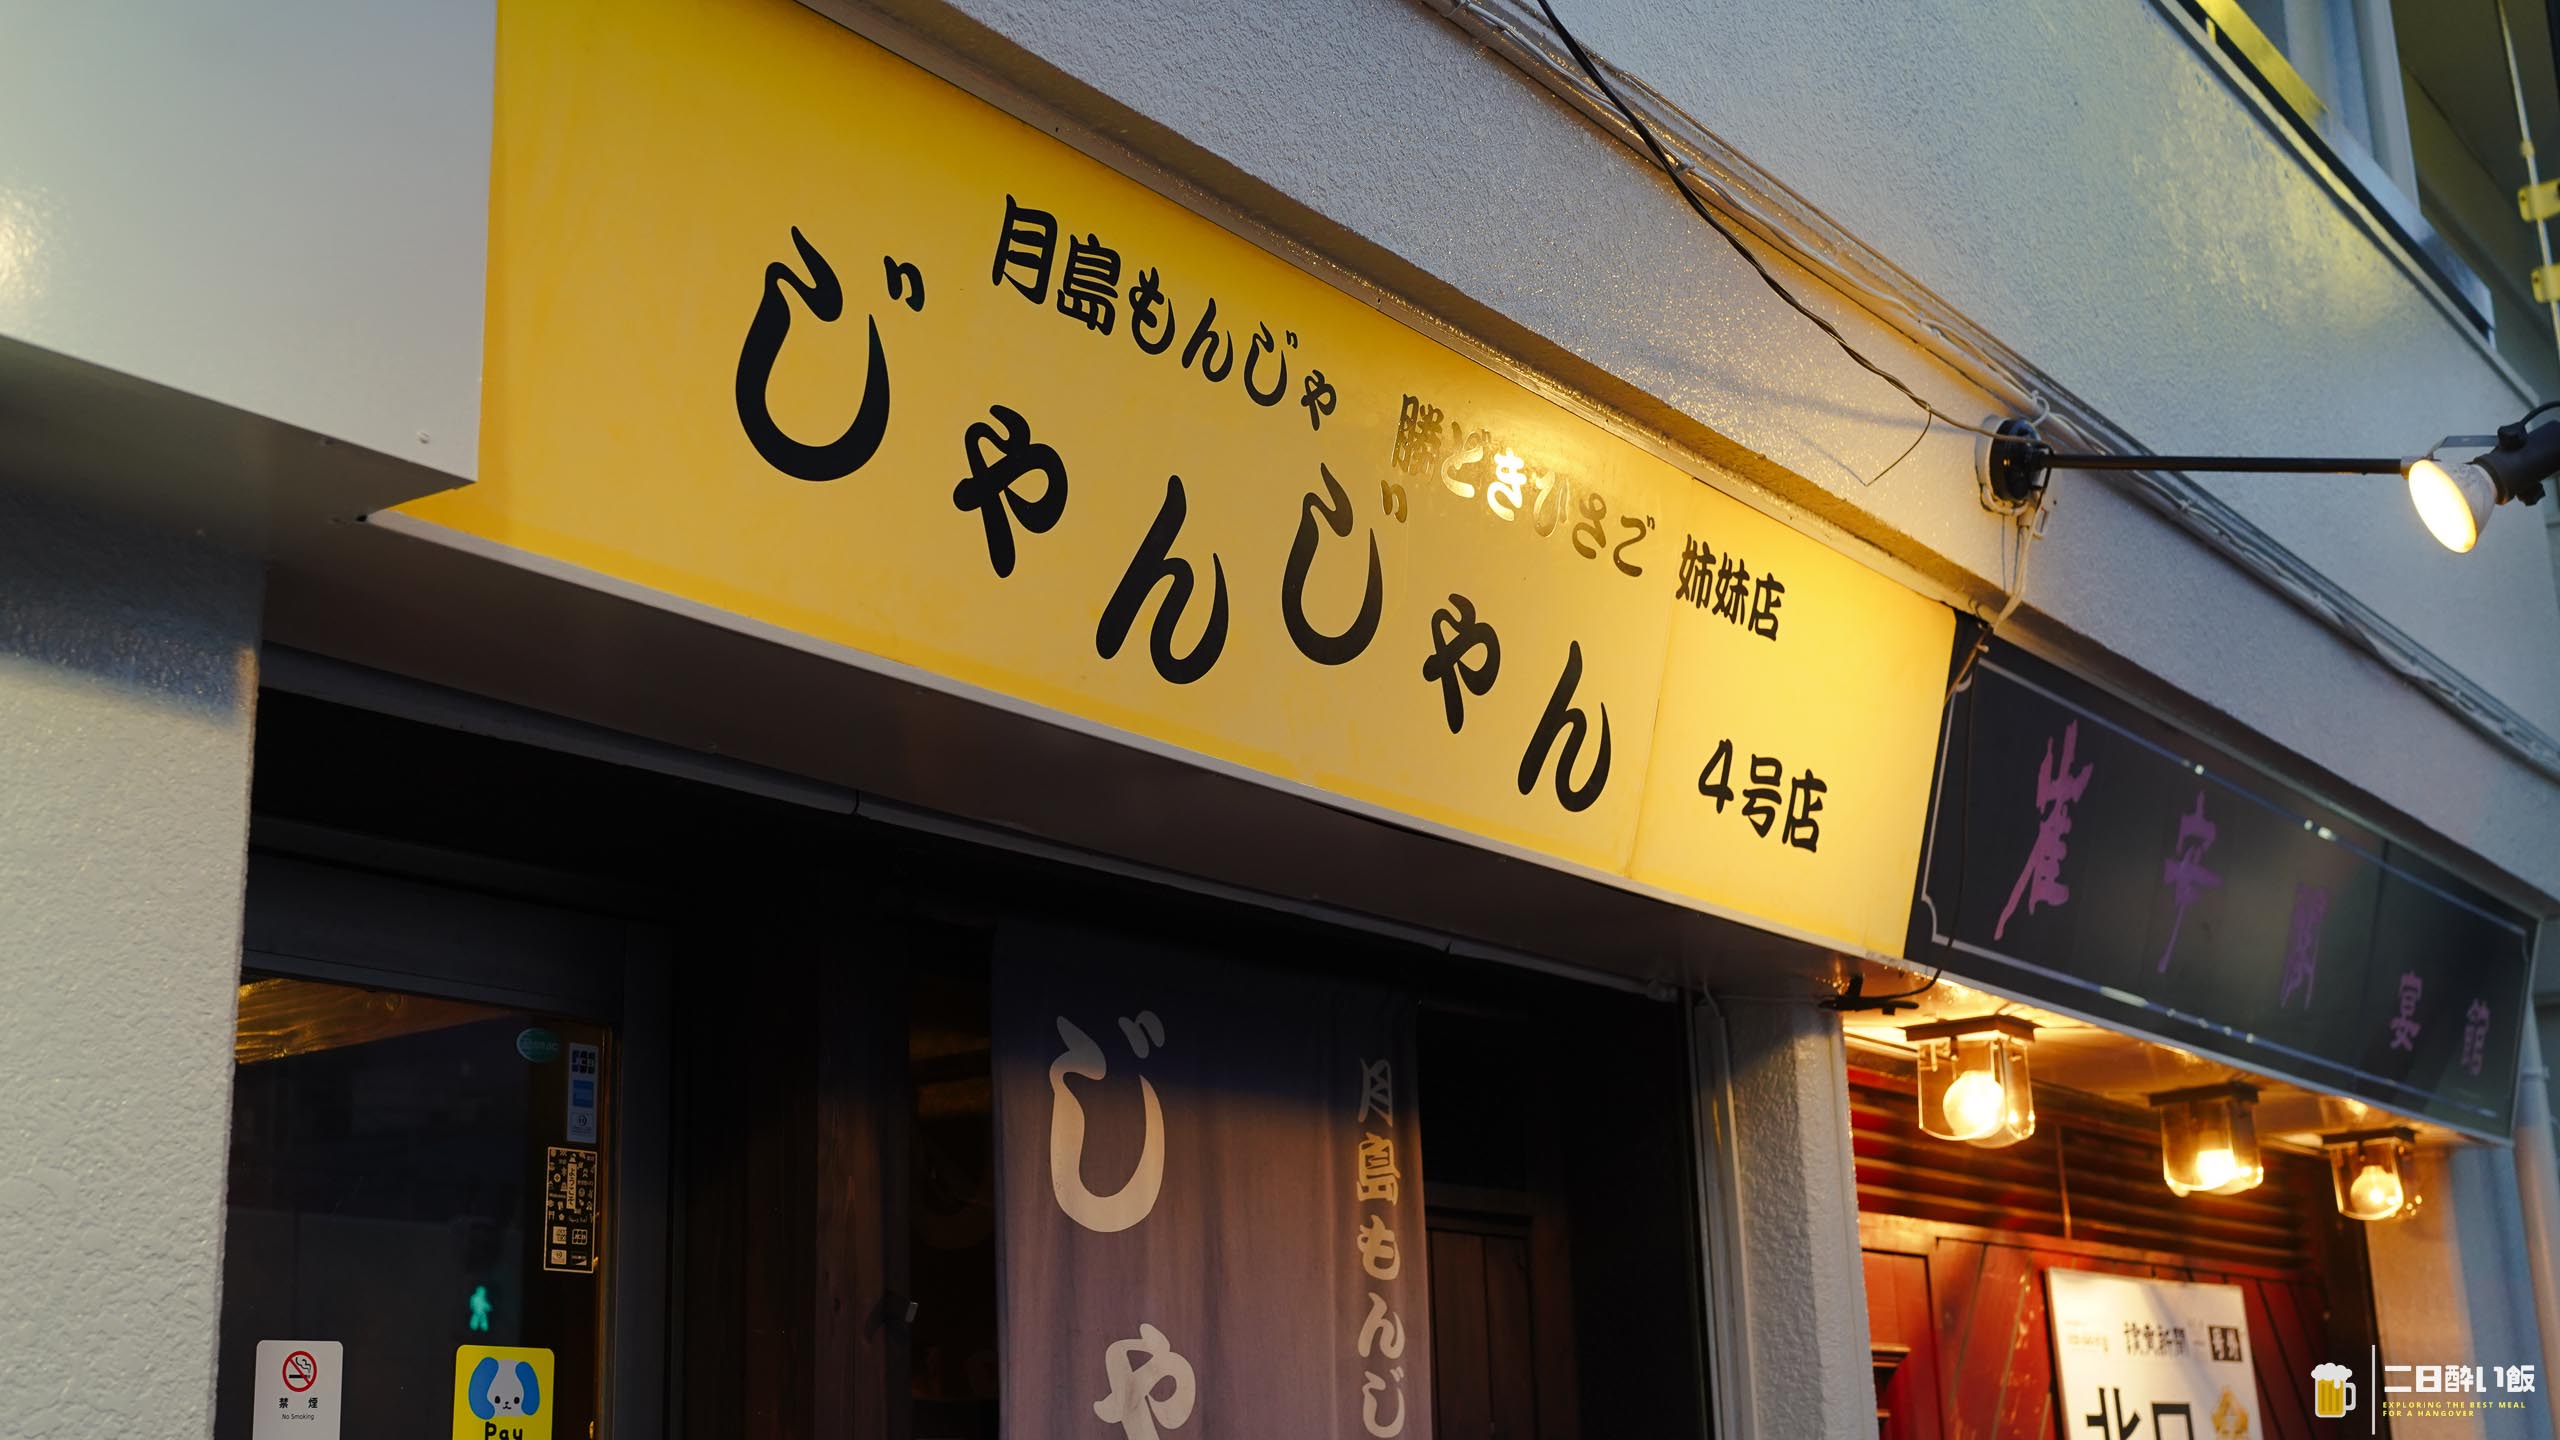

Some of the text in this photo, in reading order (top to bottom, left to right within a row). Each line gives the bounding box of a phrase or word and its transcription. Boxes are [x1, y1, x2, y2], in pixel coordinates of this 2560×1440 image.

[992, 194, 1337, 431] 月島もんじゃ
[1675, 533, 1785, 641] 姉妹店
[735, 225, 1612, 813] じゃんじゃん
[1698, 739, 1828, 852] 4号店
[290, 1413, 315, 1421] Smoking
[485, 1421, 522, 1440] Pay
